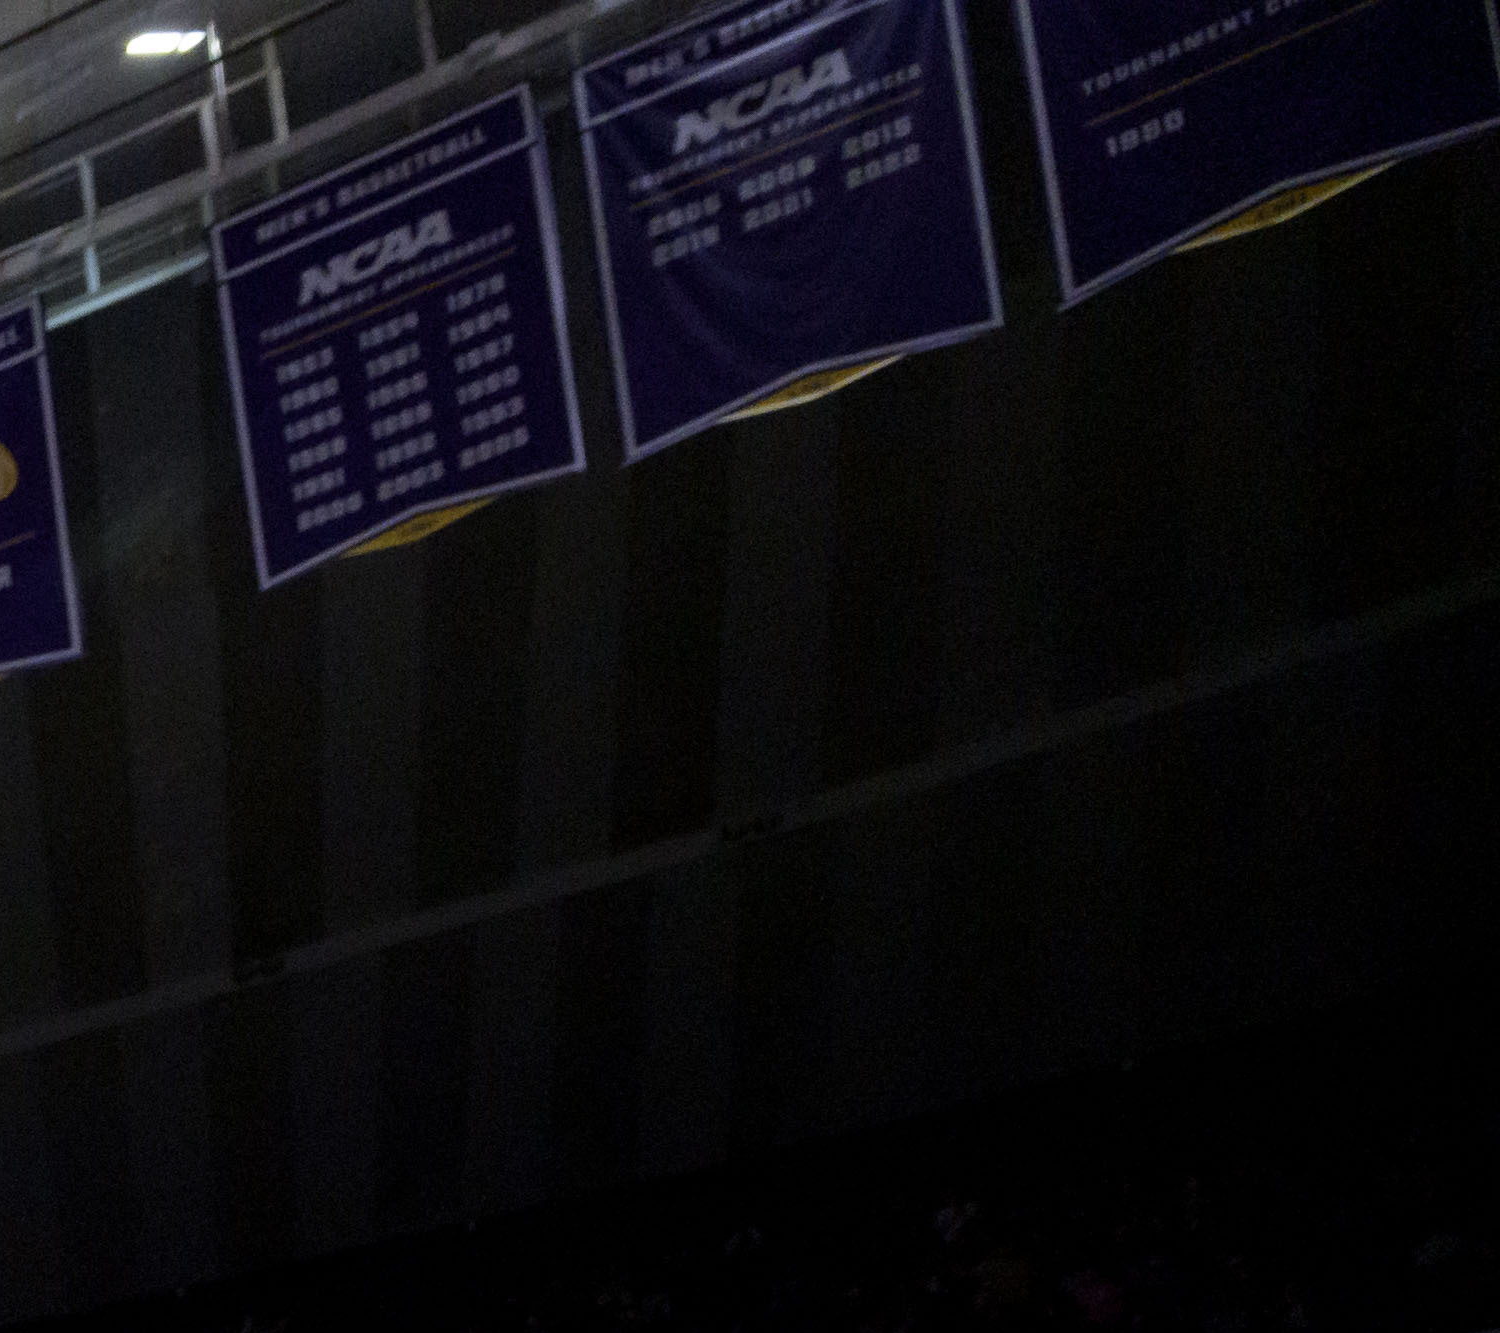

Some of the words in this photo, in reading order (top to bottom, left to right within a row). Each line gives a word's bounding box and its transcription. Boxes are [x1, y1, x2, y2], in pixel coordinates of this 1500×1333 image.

[1082, 9, 1256, 97] TOURNAMENT
[672, 48, 851, 155] NCAA
[336, 127, 488, 207] BASKETBALL
[300, 210, 455, 306] NCAA
